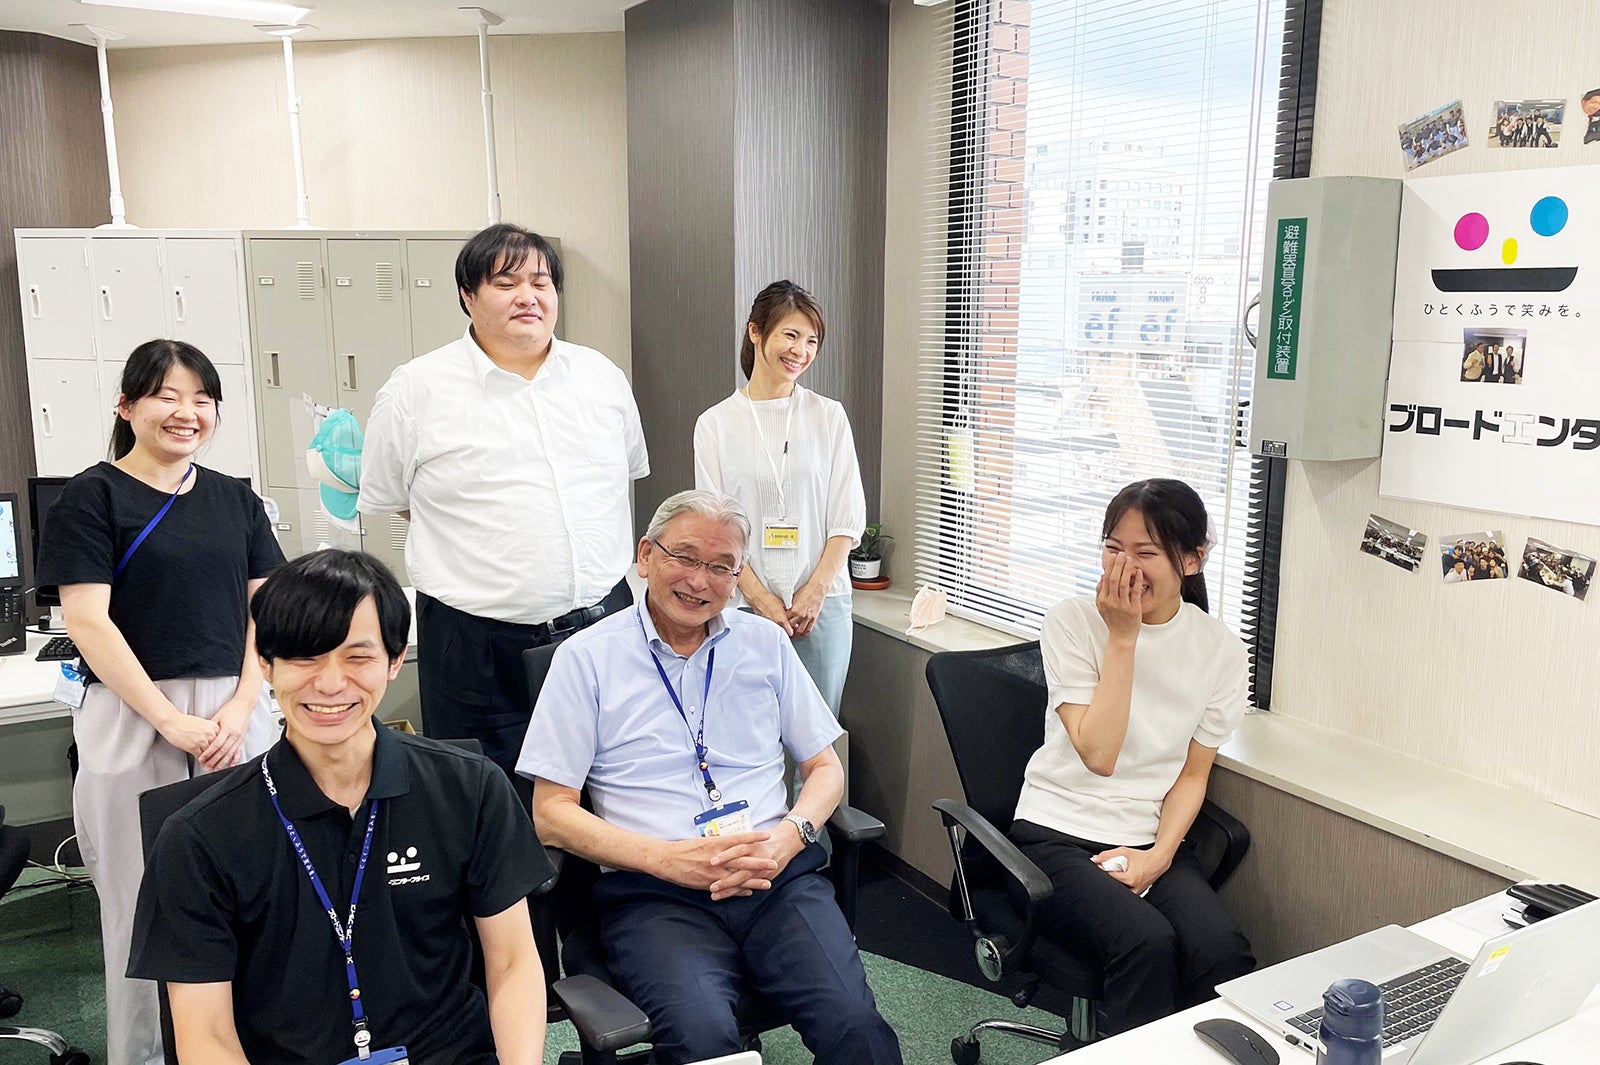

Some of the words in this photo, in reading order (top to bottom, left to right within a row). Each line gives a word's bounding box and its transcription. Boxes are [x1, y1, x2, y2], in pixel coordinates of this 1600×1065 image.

[1423, 303, 1582, 318] ひとくふうで笑みを。
[1389, 403, 1600, 450] ブロードエンタ
